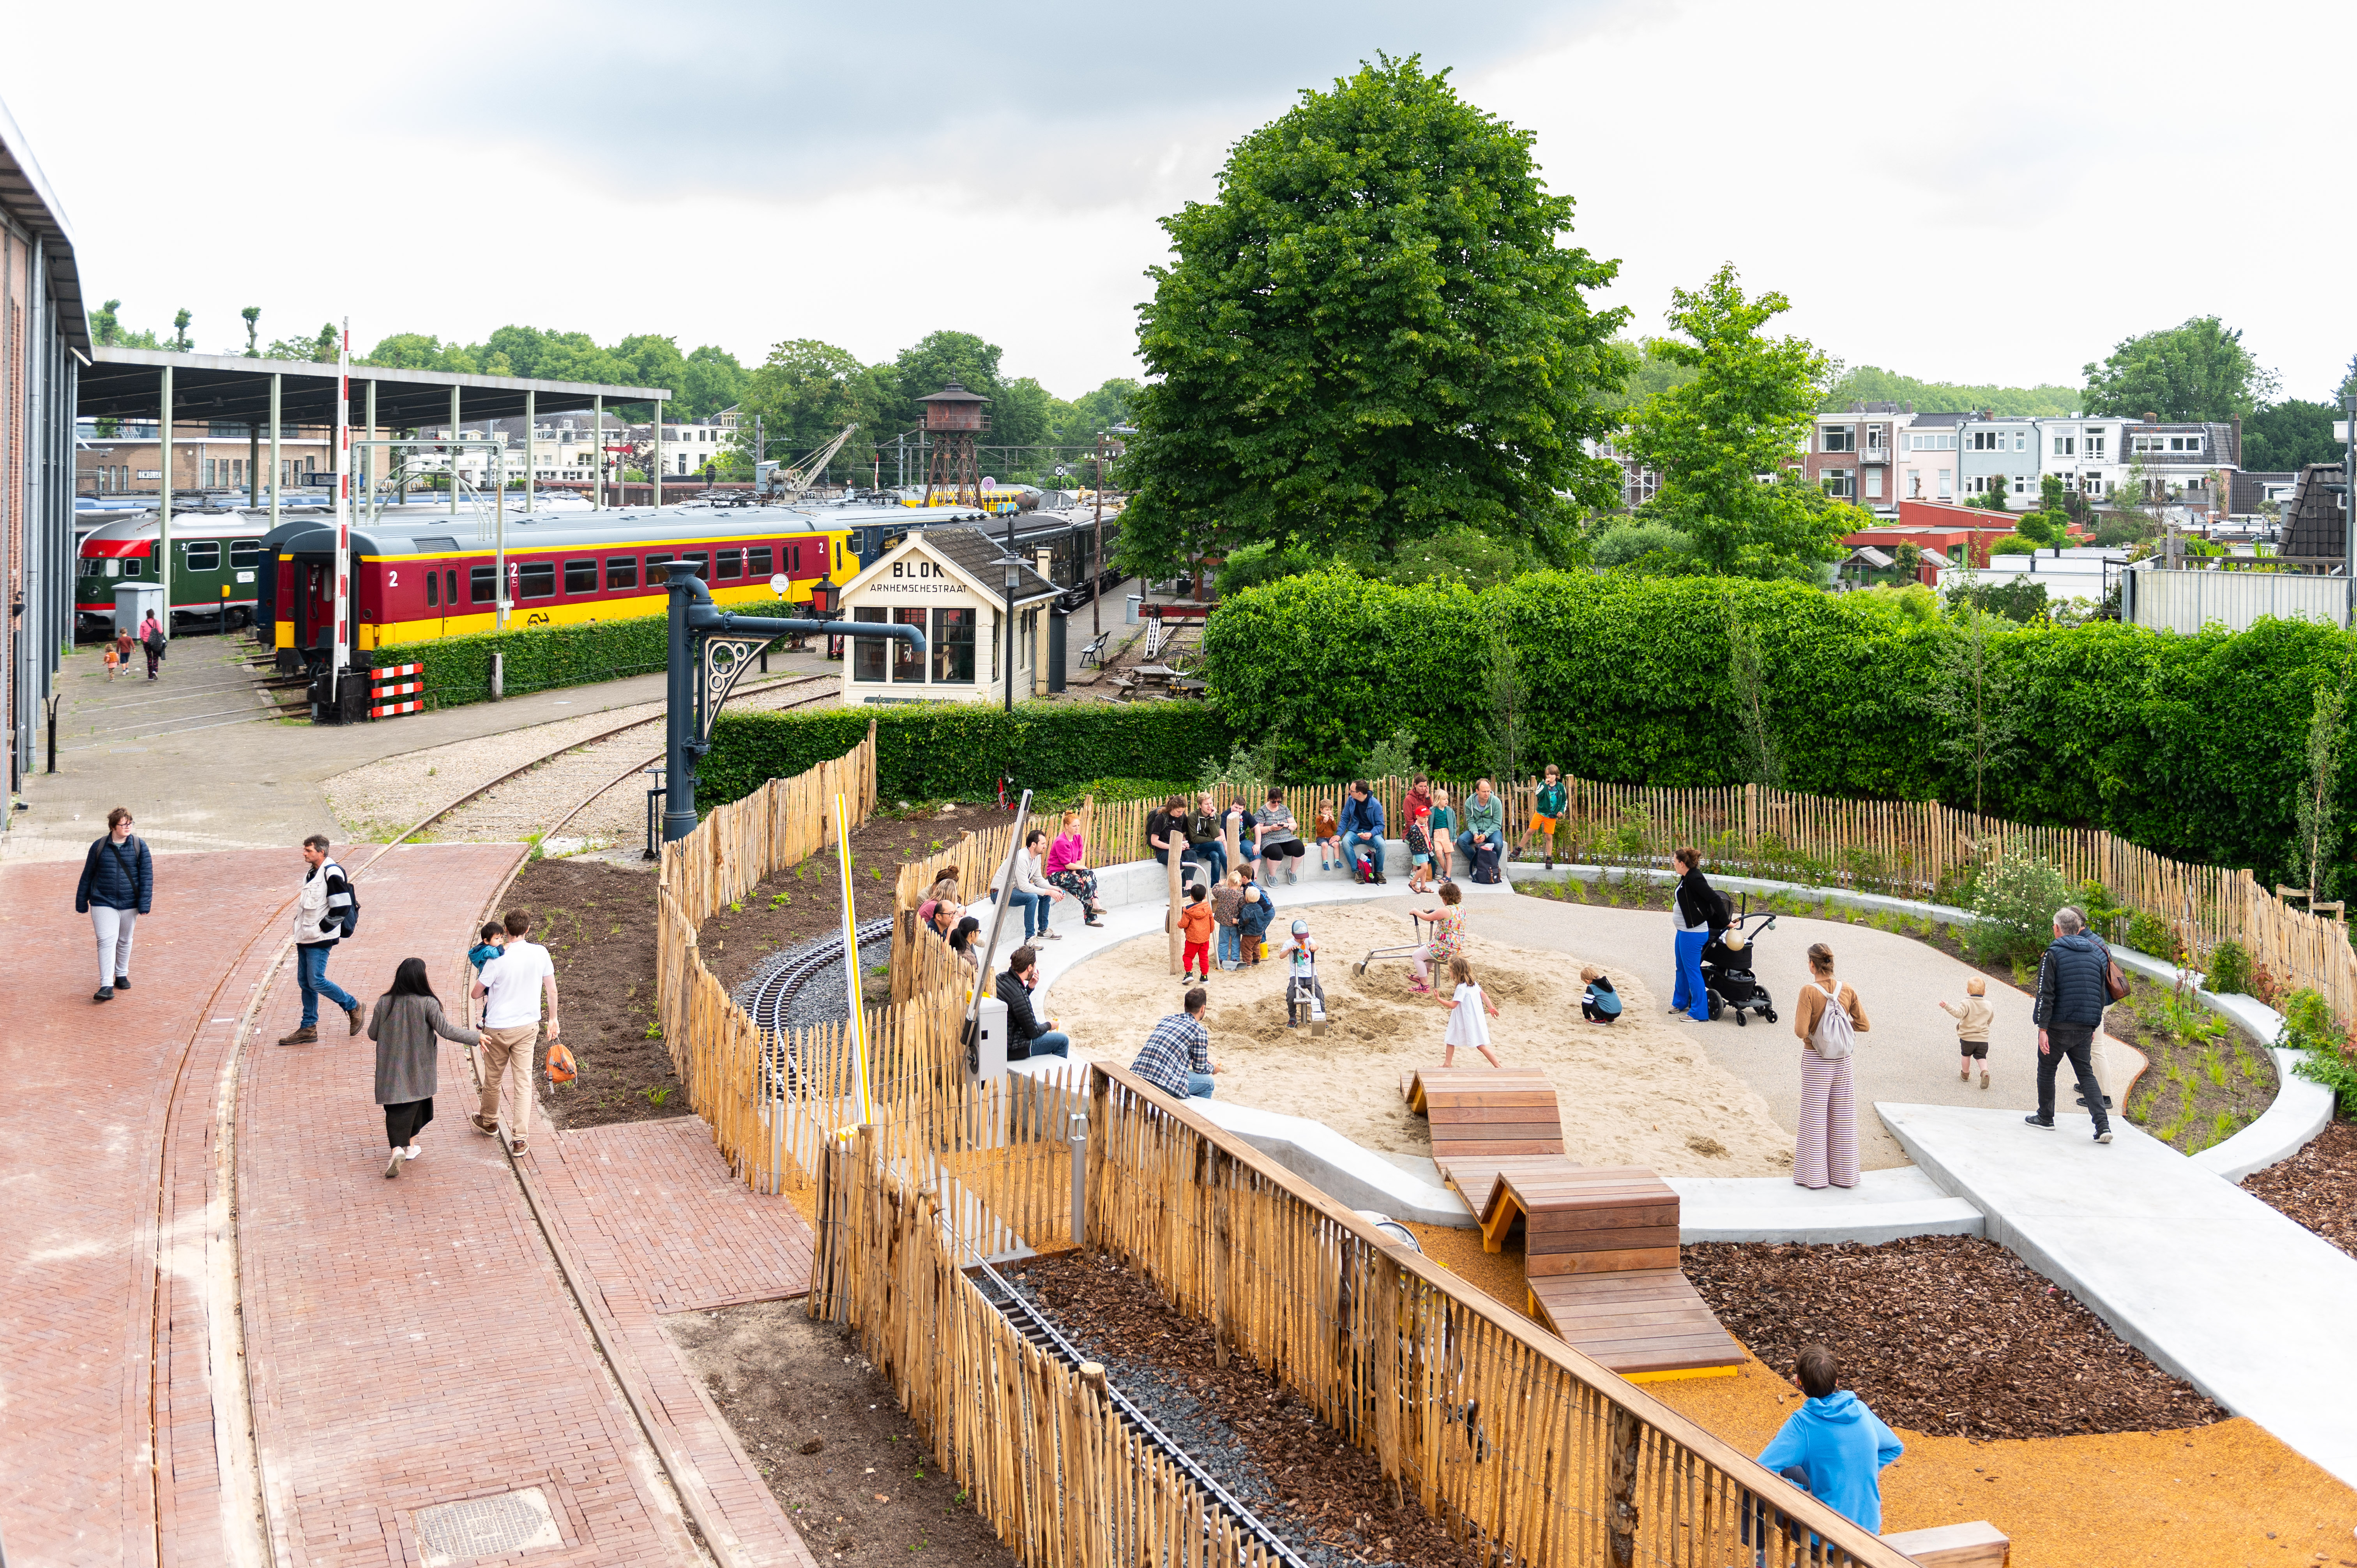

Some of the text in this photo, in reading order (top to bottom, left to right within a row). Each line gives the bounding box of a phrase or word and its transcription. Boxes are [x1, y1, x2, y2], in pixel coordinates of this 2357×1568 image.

[742, 547, 748, 559] 2
[819, 542, 824, 553] 2
[511, 562, 518, 577] 2
[893, 562, 945, 577] BLOK
[389, 570, 398, 587] 2
[870, 584, 967, 593] ARNHEMSCHESTRAAT
